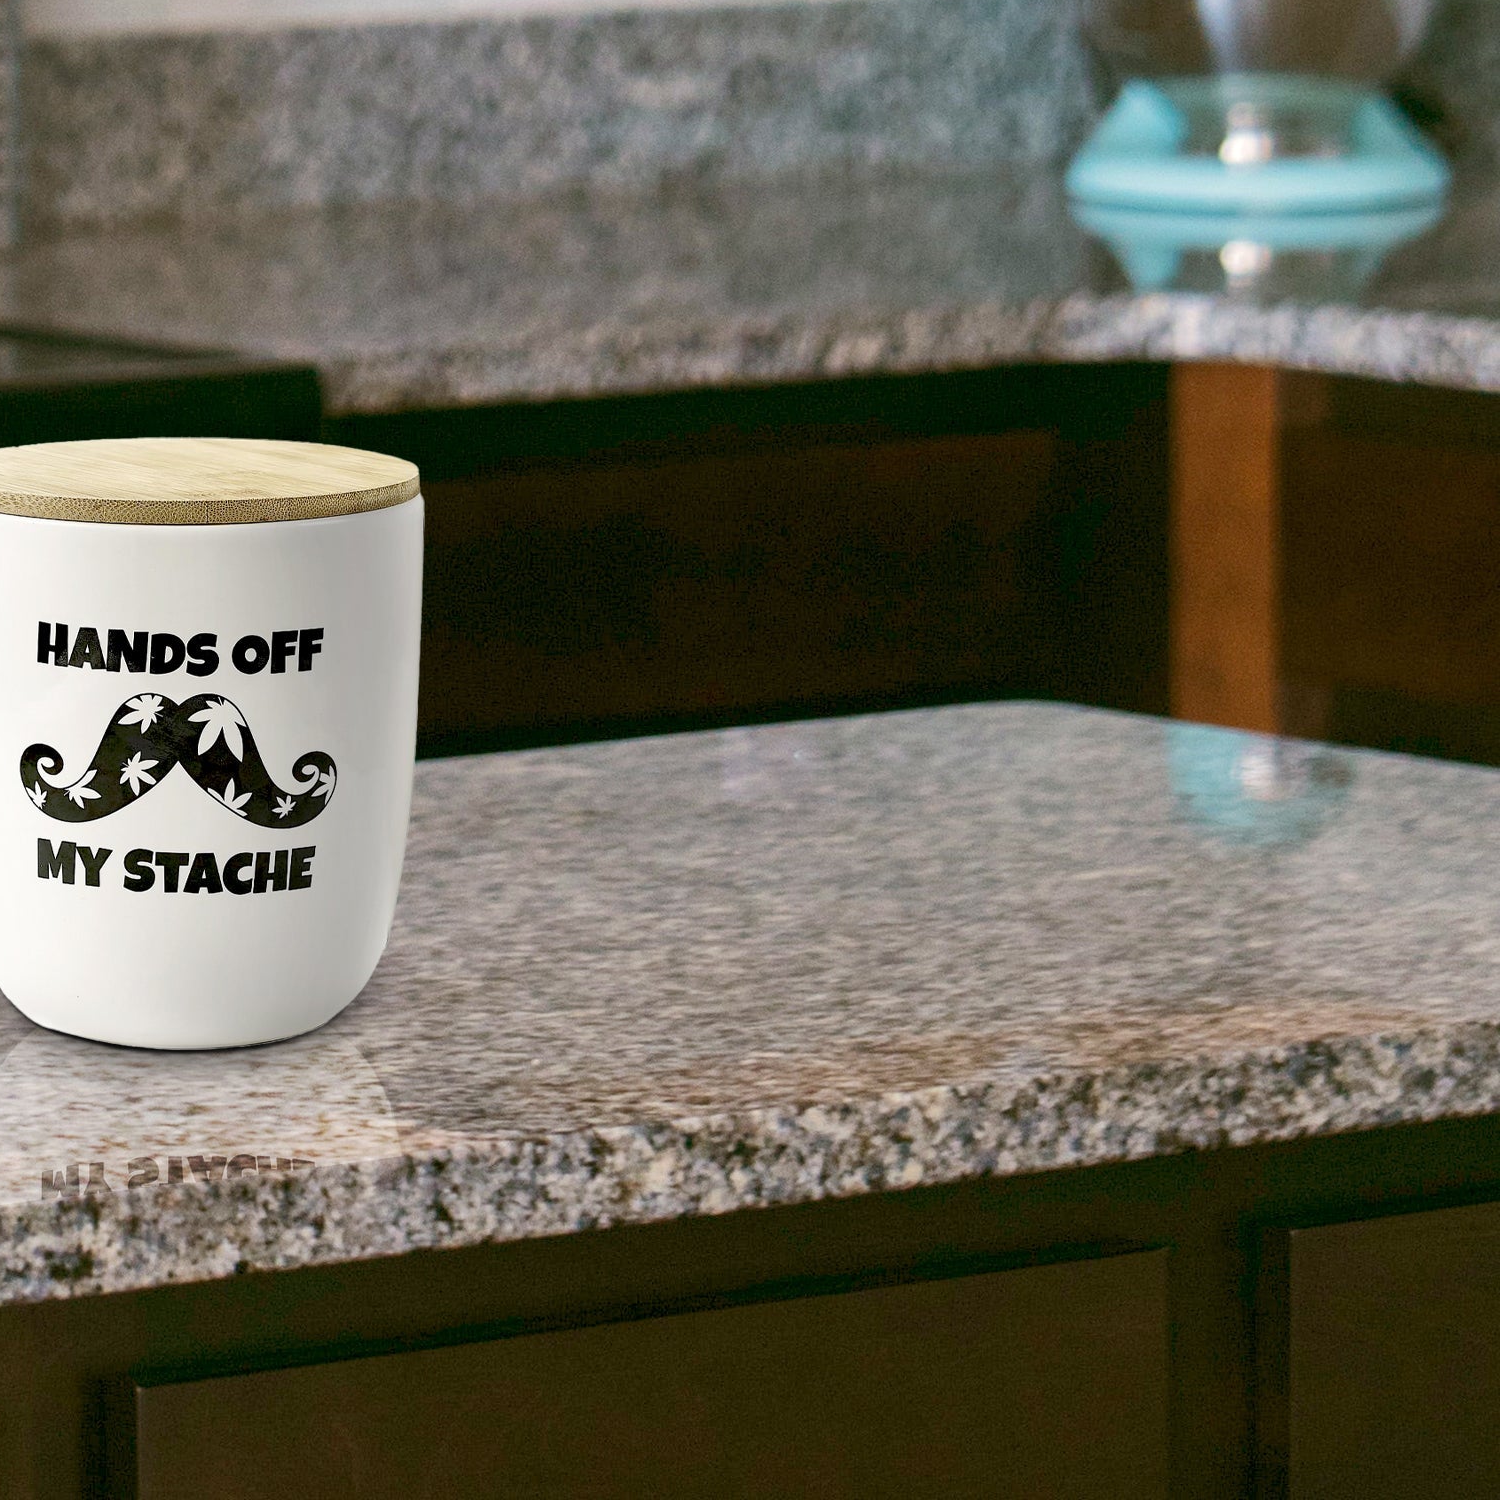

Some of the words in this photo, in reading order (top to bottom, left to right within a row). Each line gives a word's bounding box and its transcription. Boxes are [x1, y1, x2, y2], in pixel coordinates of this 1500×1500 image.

[37, 621, 219, 677] HANDS
[232, 627, 325, 675] OFF
[38, 838, 113, 888] MY
[124, 846, 316, 895] STACHE
